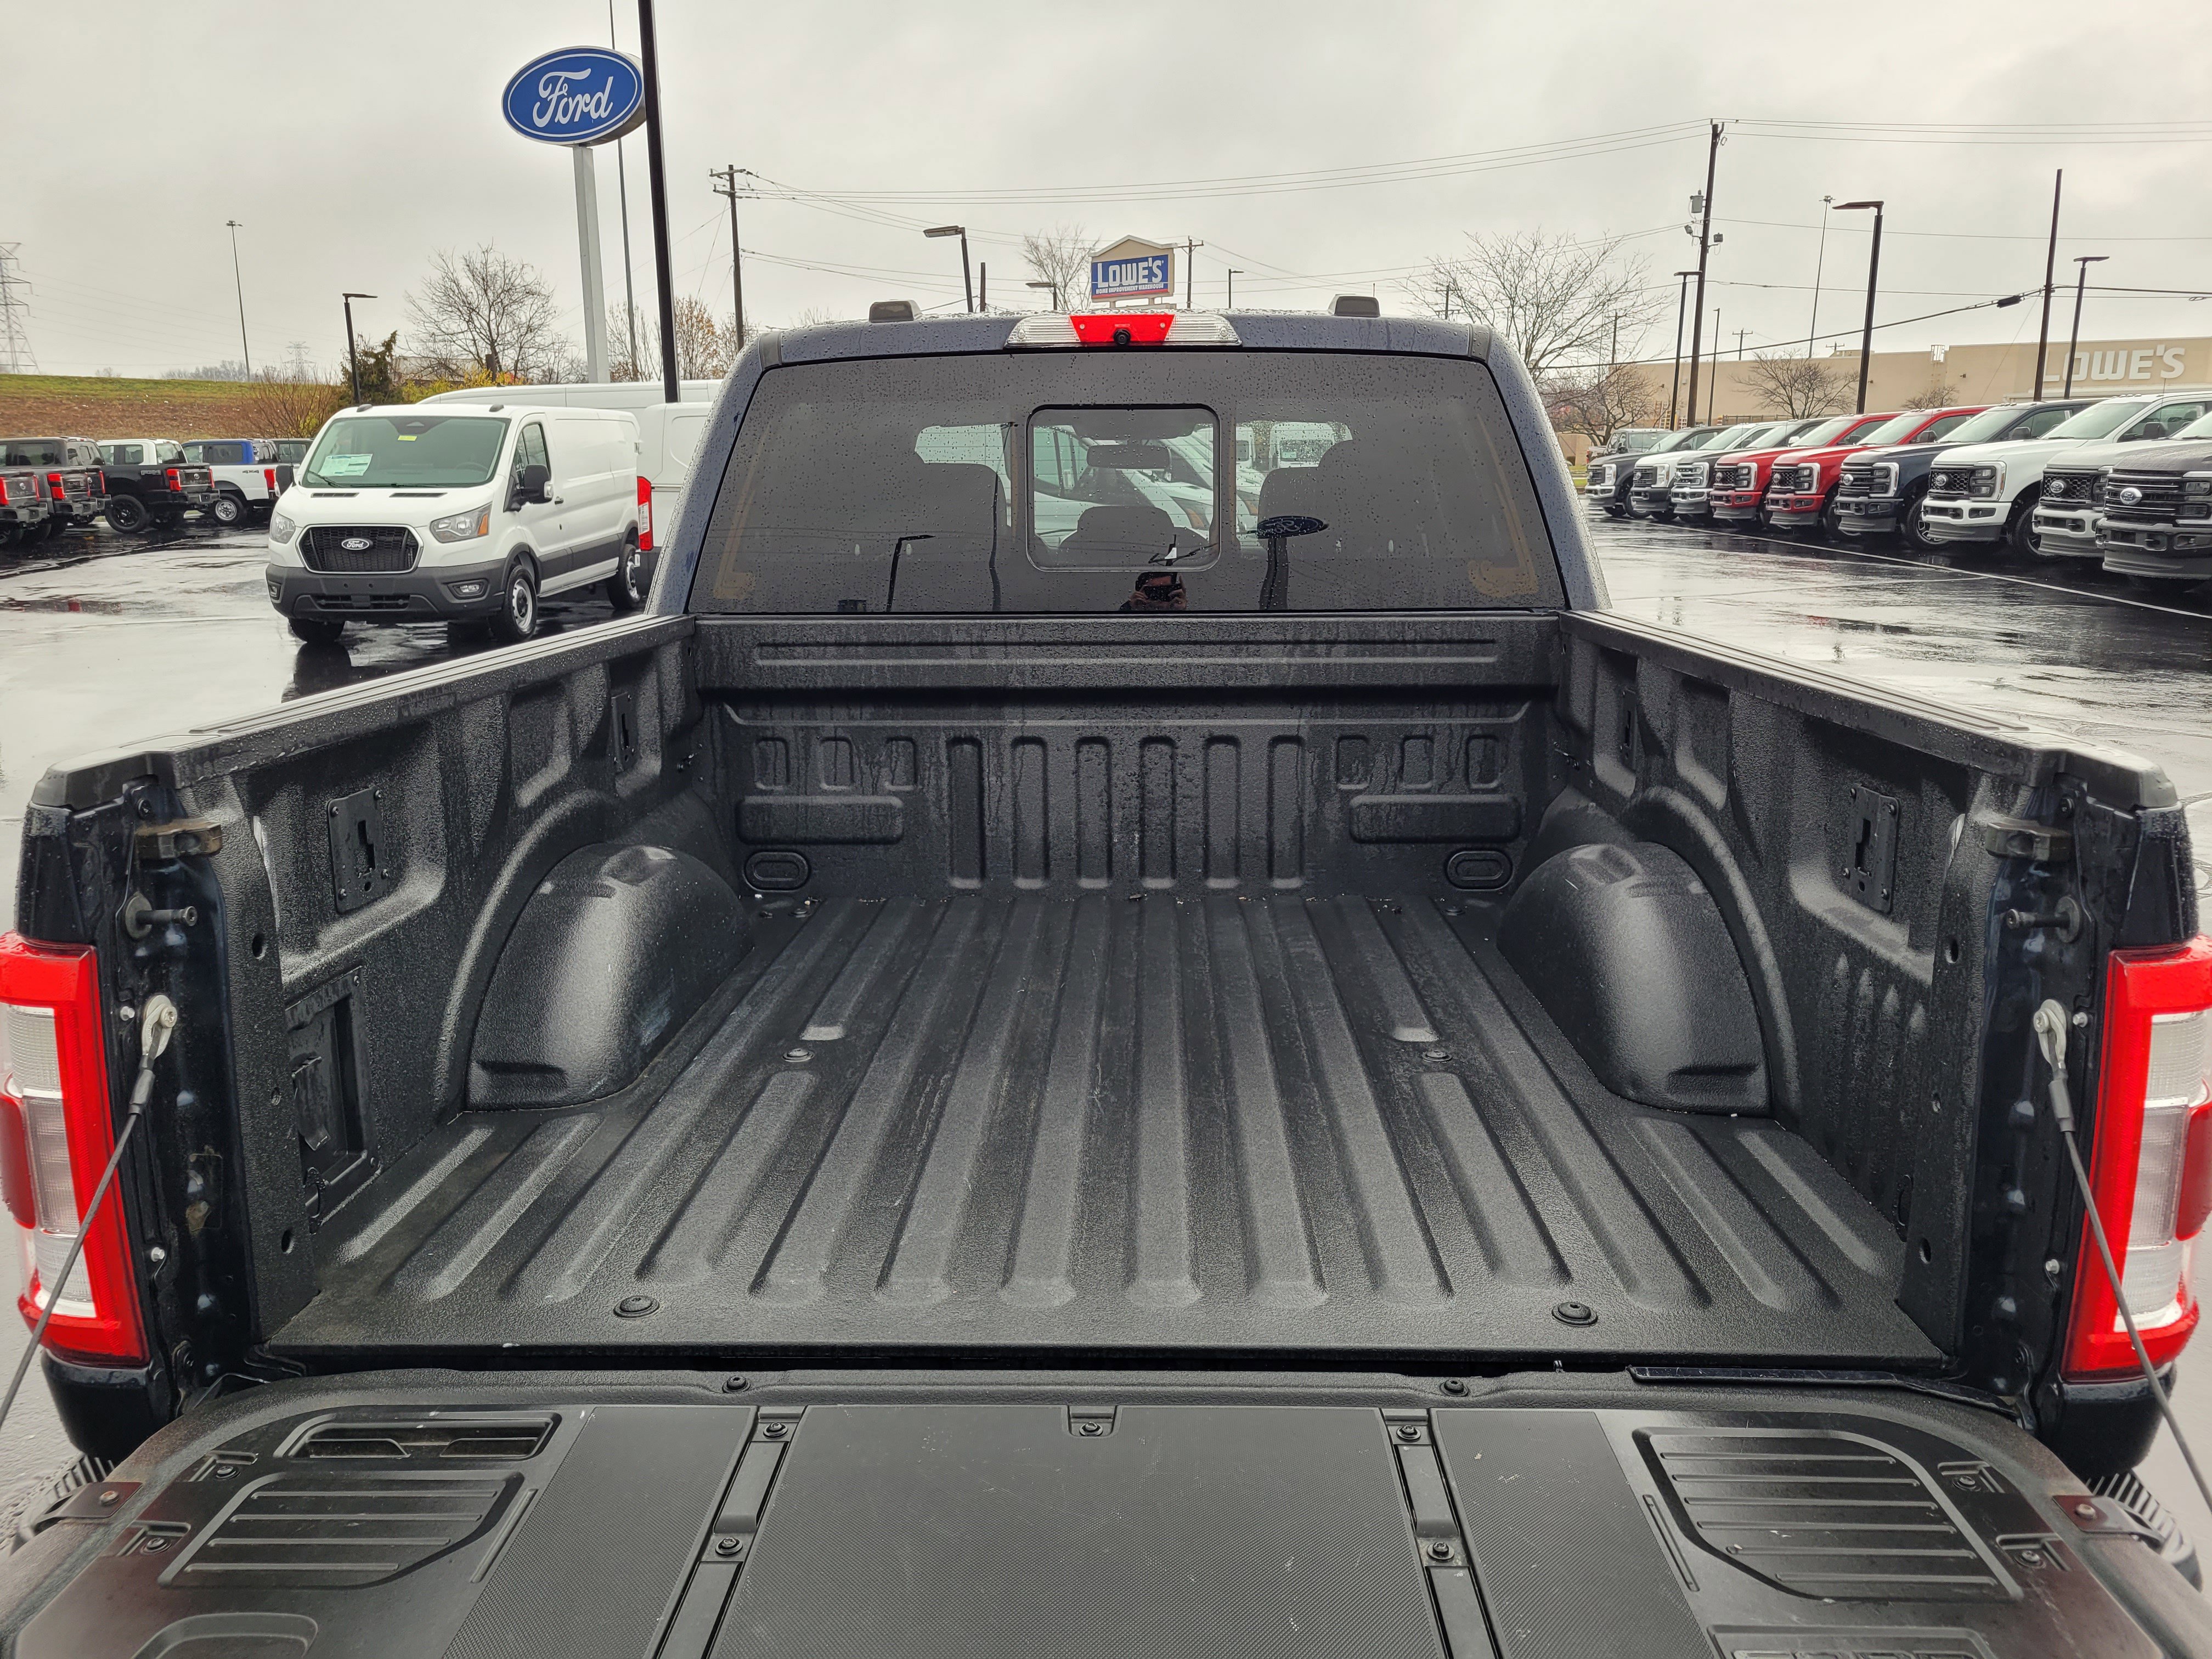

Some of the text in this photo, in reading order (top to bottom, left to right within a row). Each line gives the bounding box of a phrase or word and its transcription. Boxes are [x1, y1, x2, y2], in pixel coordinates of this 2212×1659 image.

[533, 67, 614, 128] Ford
[1097, 257, 1164, 288] LOWE'S
[1108, 285, 1138, 294] IMPROVEMENT
[2042, 344, 2186, 382] LOWE'S
